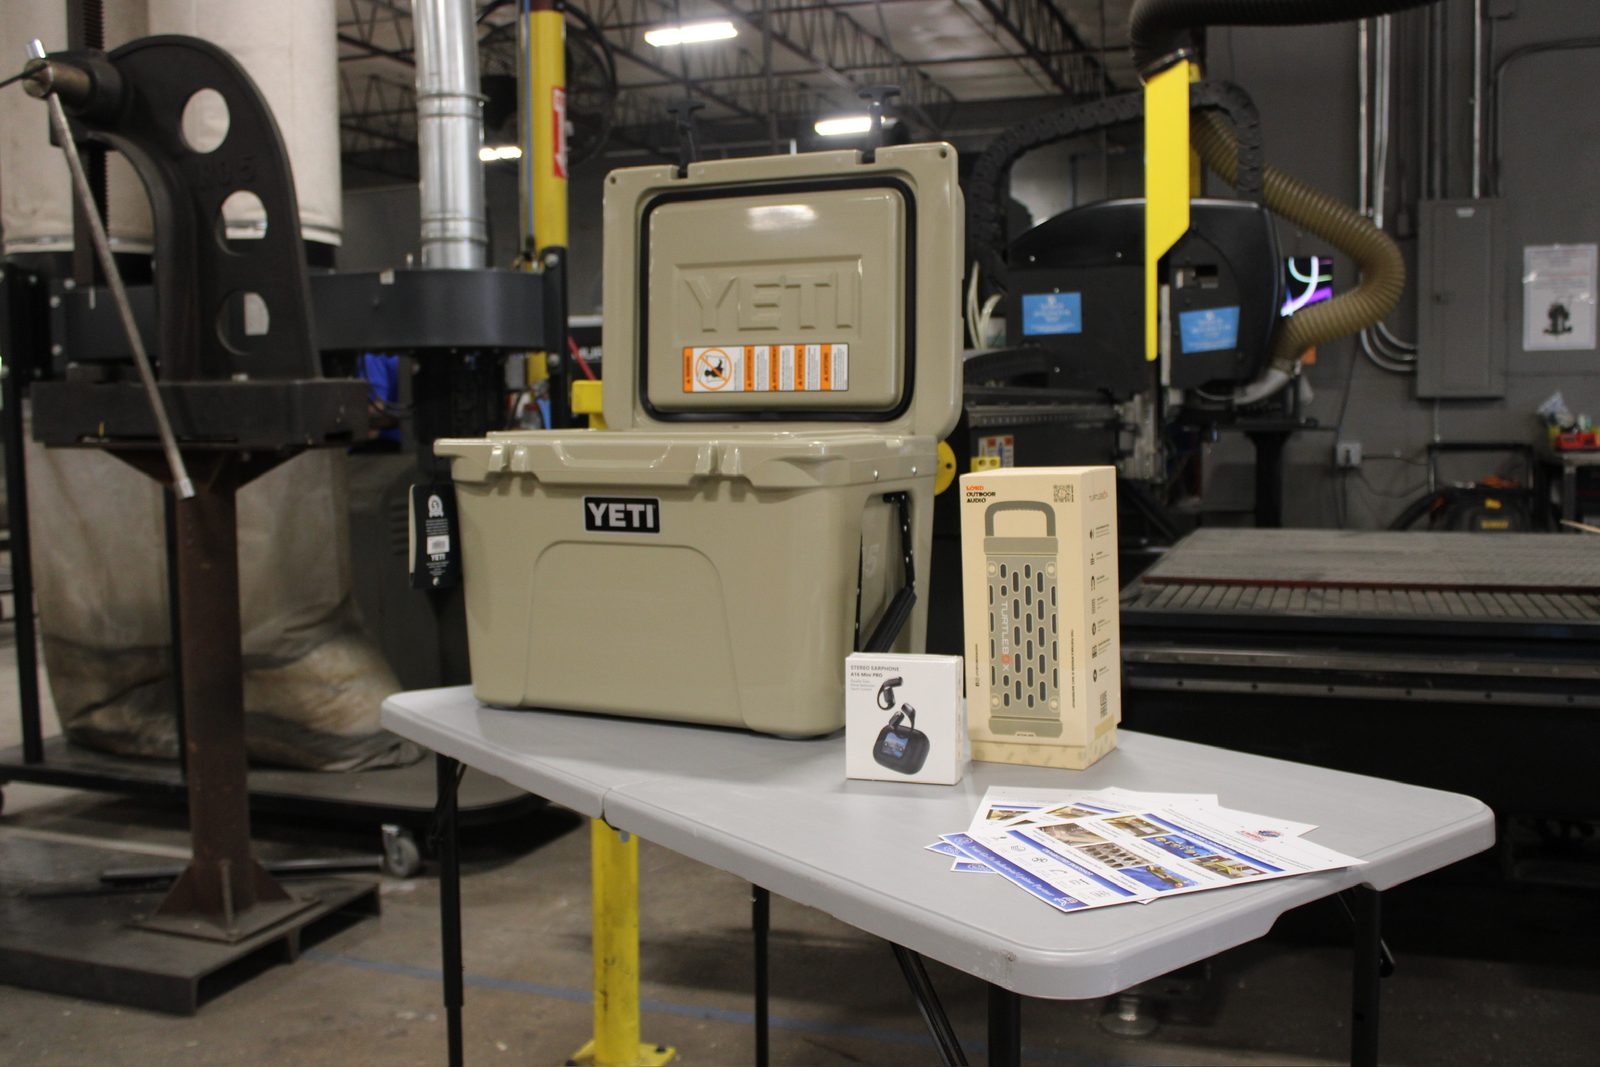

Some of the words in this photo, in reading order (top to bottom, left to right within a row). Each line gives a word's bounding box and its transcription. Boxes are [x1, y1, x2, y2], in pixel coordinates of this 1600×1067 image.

[684, 270, 853, 332] YETI
[587, 502, 656, 529] YETI
[430, 553, 446, 562] YETI
[1001, 600, 1012, 672] TURTLEBOX
